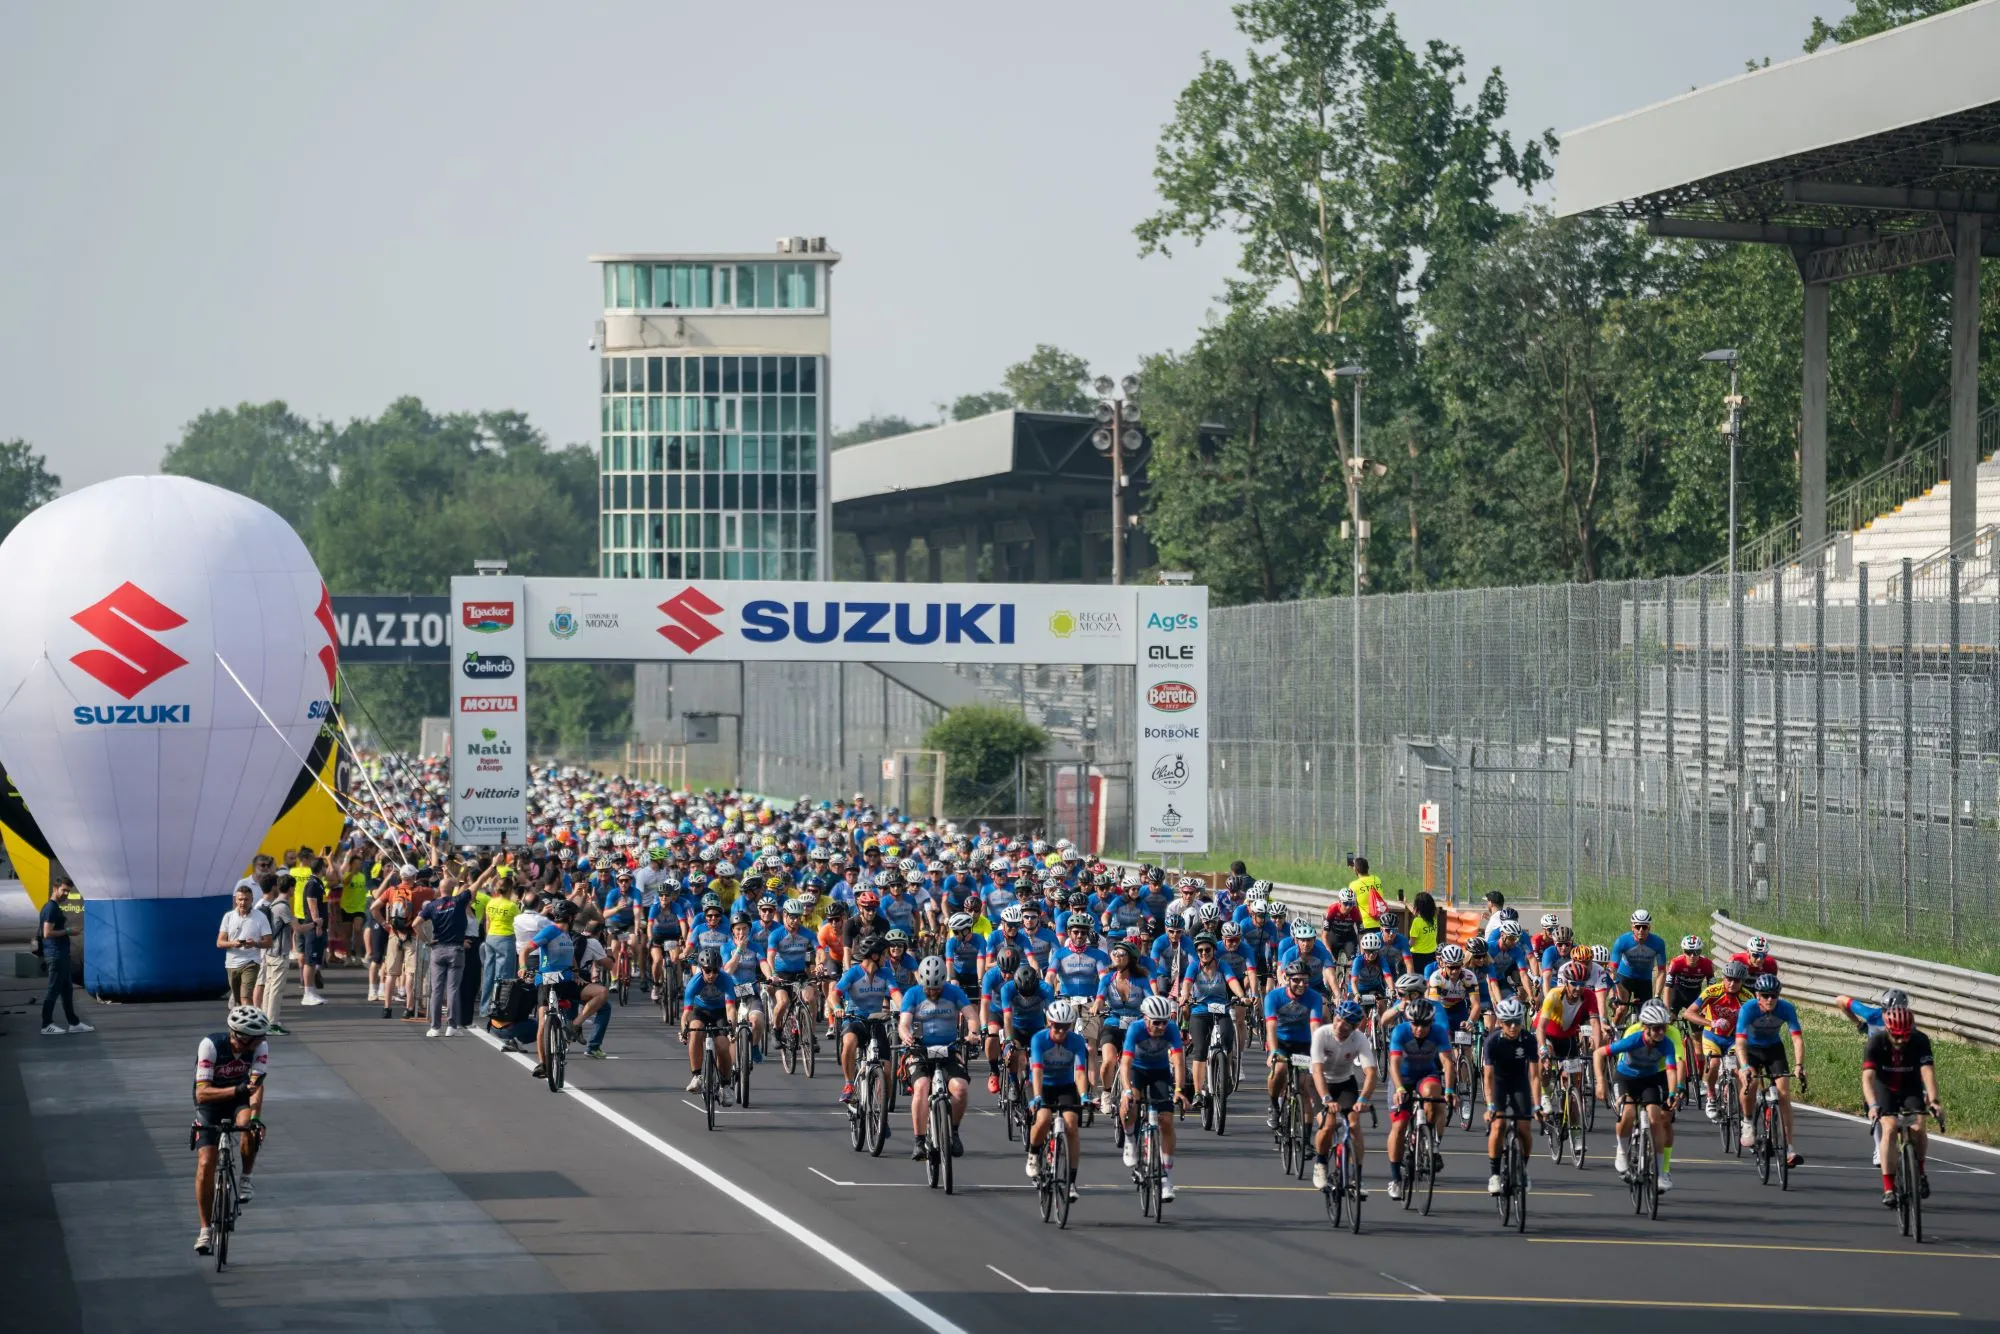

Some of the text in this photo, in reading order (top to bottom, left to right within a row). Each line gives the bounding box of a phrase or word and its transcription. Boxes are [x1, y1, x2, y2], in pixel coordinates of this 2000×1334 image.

[466, 605, 510, 619] Loacker
[1080, 612, 1118, 621] REGGIA
[585, 619, 620, 628] MONZA
[740, 600, 1015, 645] SUZUKI
[1080, 622, 1121, 631] MONZA
[1147, 612, 1198, 632] Agos
[465, 660, 512, 673] Melinda
[1148, 662, 1194, 670] alecycling.com
[1149, 688, 1195, 705] Beretta
[463, 698, 515, 711] MOTUL
[74, 705, 190, 725] SUZUKI
[1144, 727, 1200, 738] BORBONE
[475, 787, 520, 798] vittoria
[476, 816, 519, 825] Vittoria
[487, 906, 509, 916] STAFF
